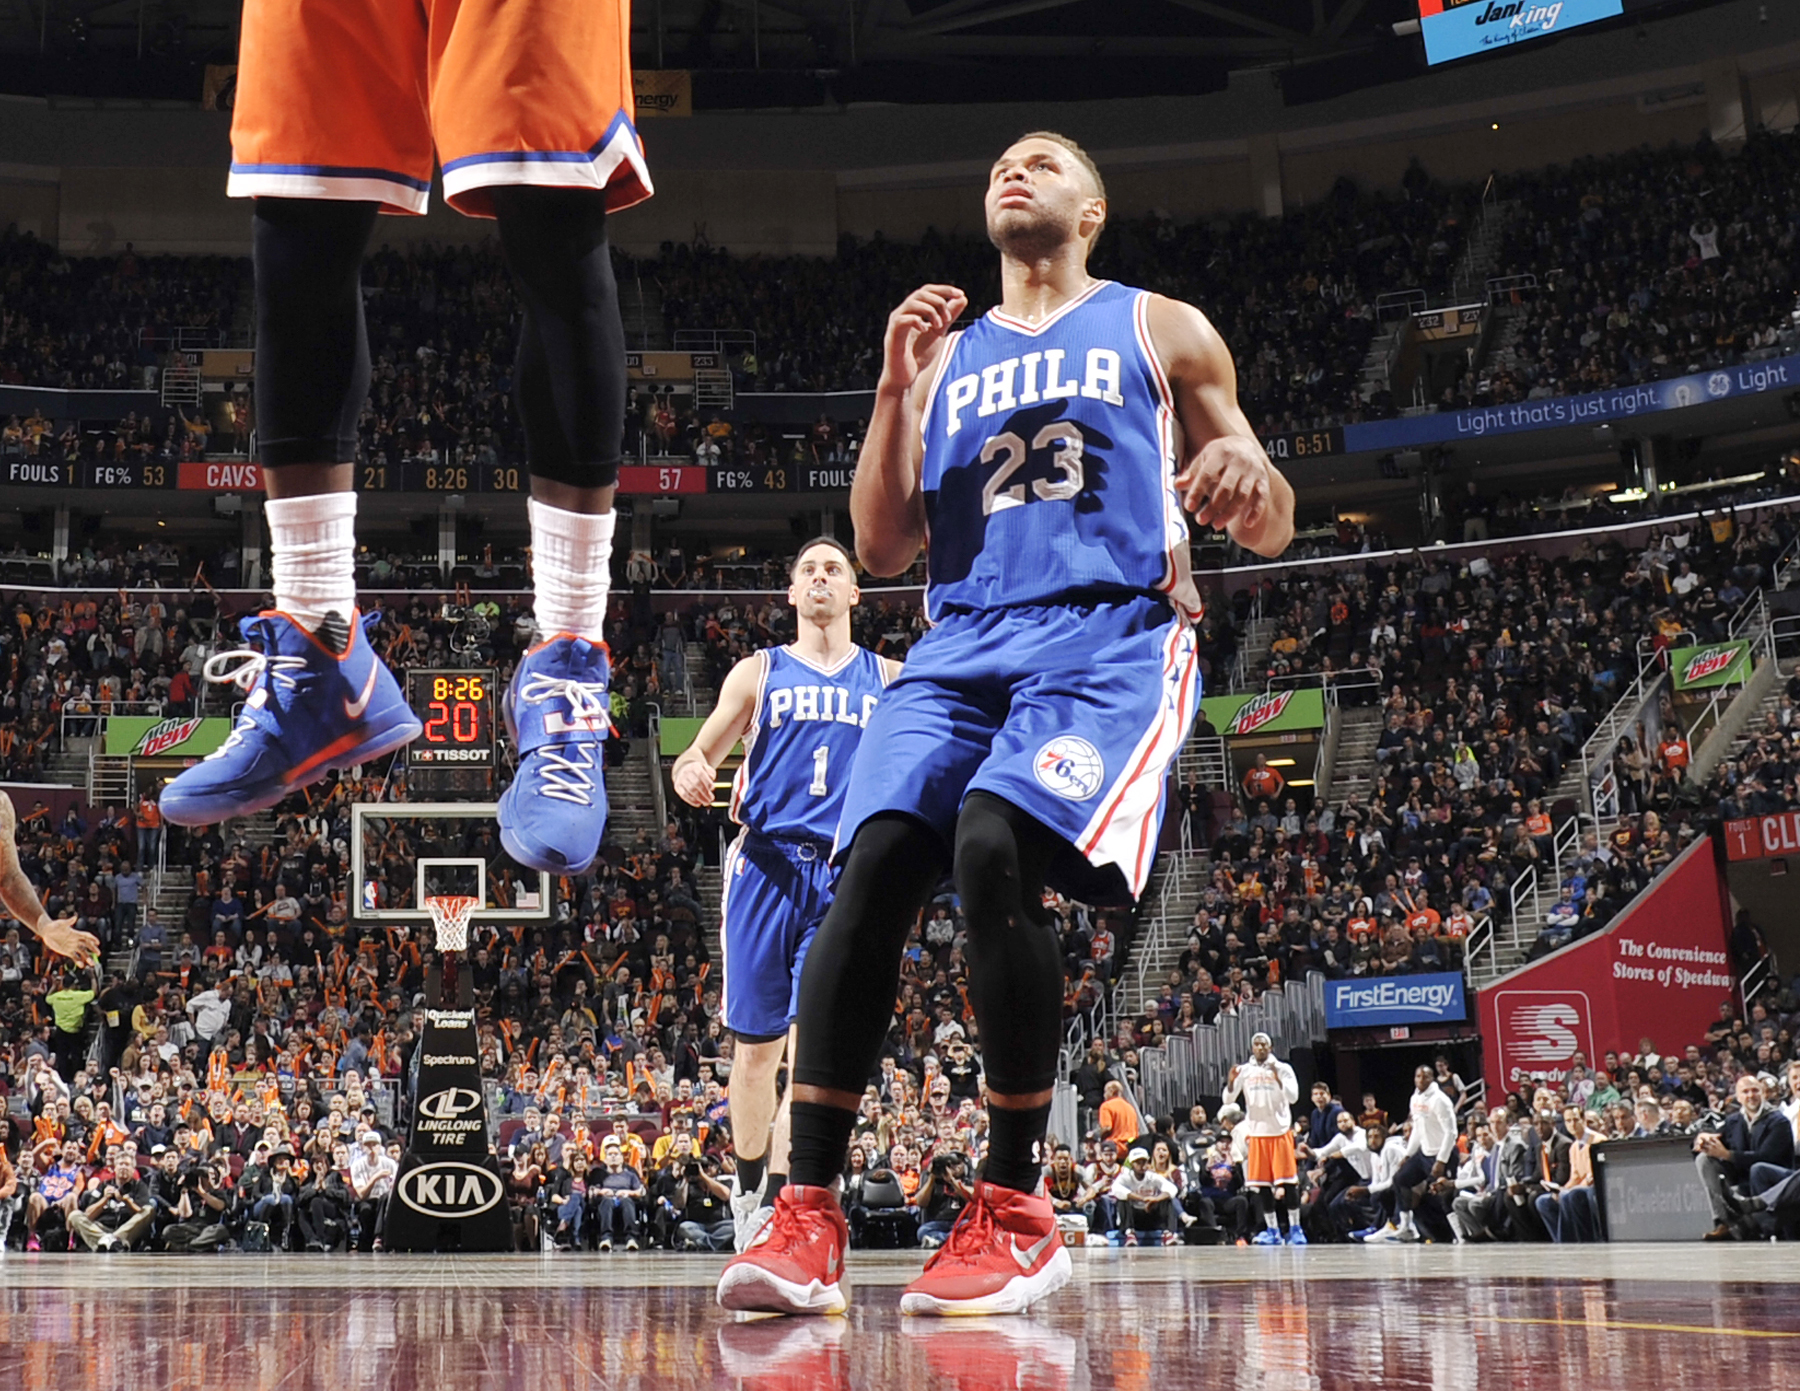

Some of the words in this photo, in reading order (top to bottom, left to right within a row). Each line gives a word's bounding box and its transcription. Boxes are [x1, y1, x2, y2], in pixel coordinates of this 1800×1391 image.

[945, 347, 1124, 438] PHILA
[1457, 412, 1505, 435] Light
[1510, 402, 1565, 426] that's
[1569, 397, 1604, 424] just
[1611, 387, 1661, 414] right.
[1738, 364, 1788, 392] Light
[1295, 434, 1333, 456] 6:51
[9, 462, 60, 484] FOULS
[95, 466, 132, 485] FG%
[142, 465, 165, 486] 53
[205, 463, 257, 488] CAVS
[425, 467, 468, 490] 8:26
[493, 468, 519, 492] 3Q
[658, 468, 683, 491] 57
[716, 469, 753, 489] FG%
[763, 469, 787, 490] 43
[980, 420, 1085, 517] 23
[434, 677, 484, 701] 8:26
[424, 702, 478, 742] 20
[433, 749, 491, 761] TISSOT
[809, 745, 829, 796] 1
[1738, 833, 1746, 855] 1
[1619, 939, 1644, 957] The
[1646, 941, 1727, 965] Convenience
[1613, 961, 1655, 981] Stores
[1657, 966, 1673, 988] of
[1675, 966, 1736, 992] Speedway
[1336, 982, 1454, 1008] FirstEnergy
[428, 1009, 473, 1020] Quicken
[434, 1019, 468, 1029] Loans
[423, 1054, 476, 1067] Spectrum
[417, 1119, 482, 1131] LINGLONG
[432, 1133, 465, 1145] TIRE
[417, 1173, 485, 1206] KIA
